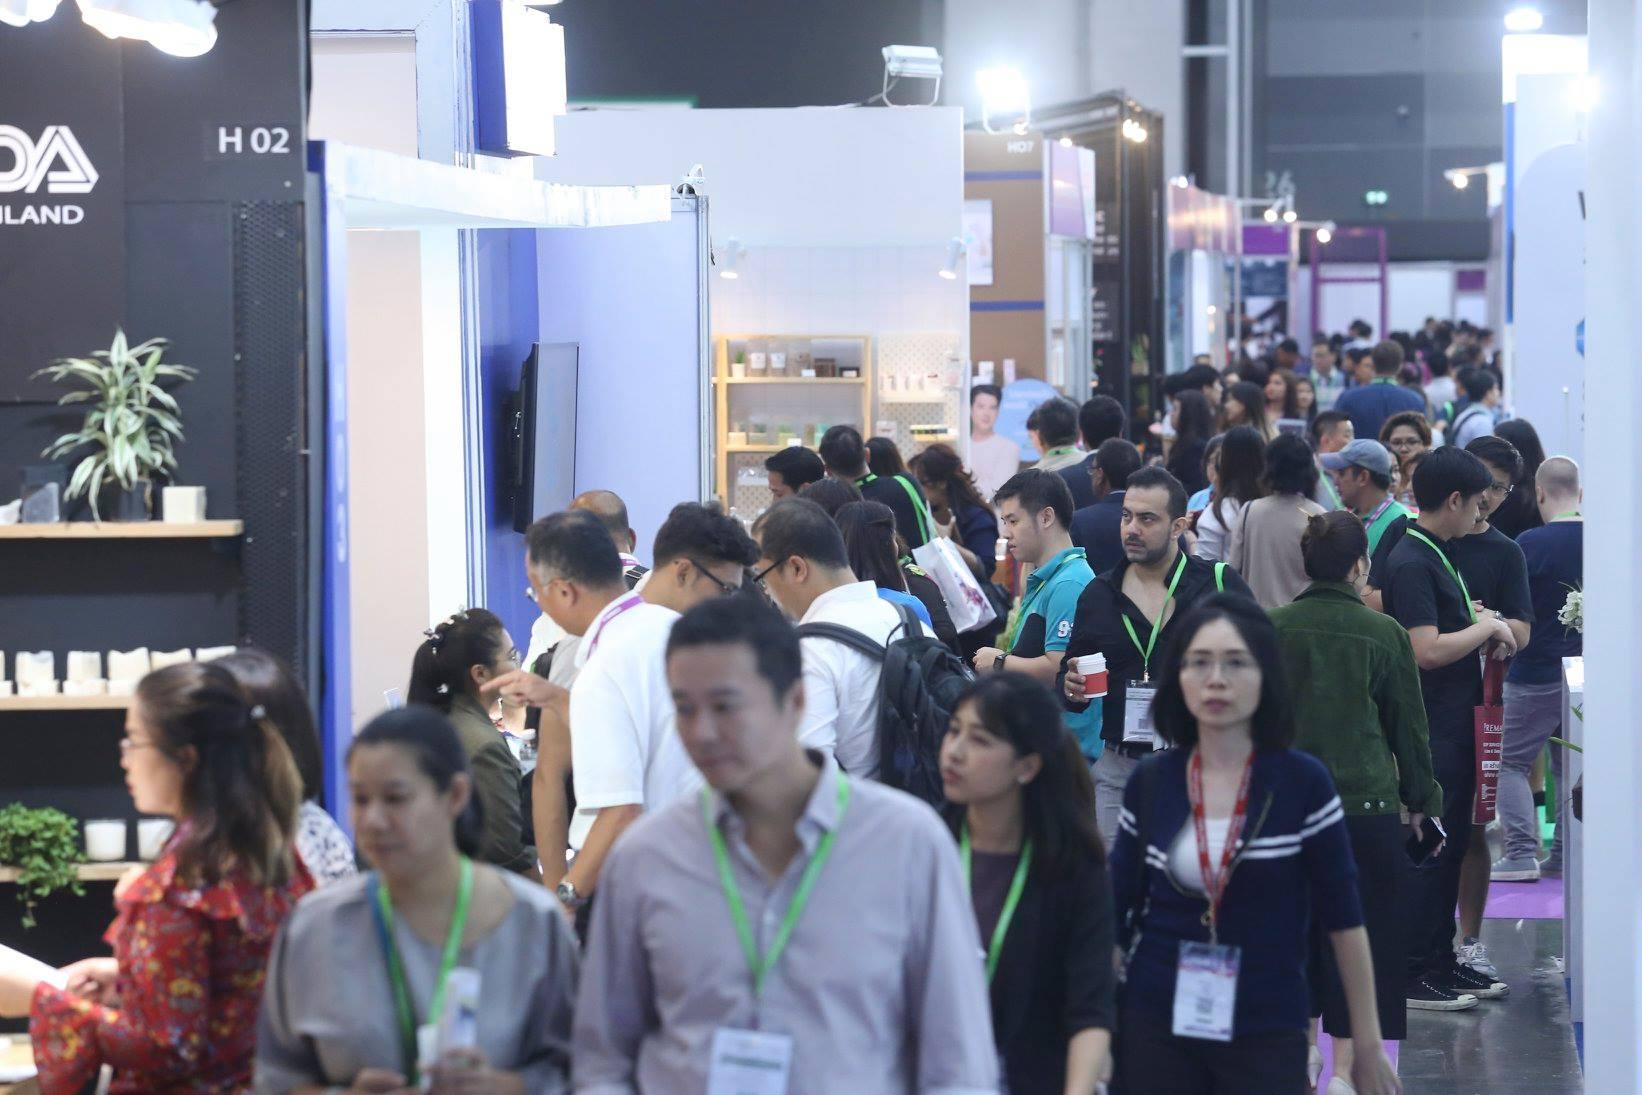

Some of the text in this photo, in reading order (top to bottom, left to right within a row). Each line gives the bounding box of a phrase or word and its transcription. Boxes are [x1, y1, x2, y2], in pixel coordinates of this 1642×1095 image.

[219, 127, 290, 153] H 02
[1057, 620, 1073, 637] 9
[1483, 722, 1502, 732] PREM
